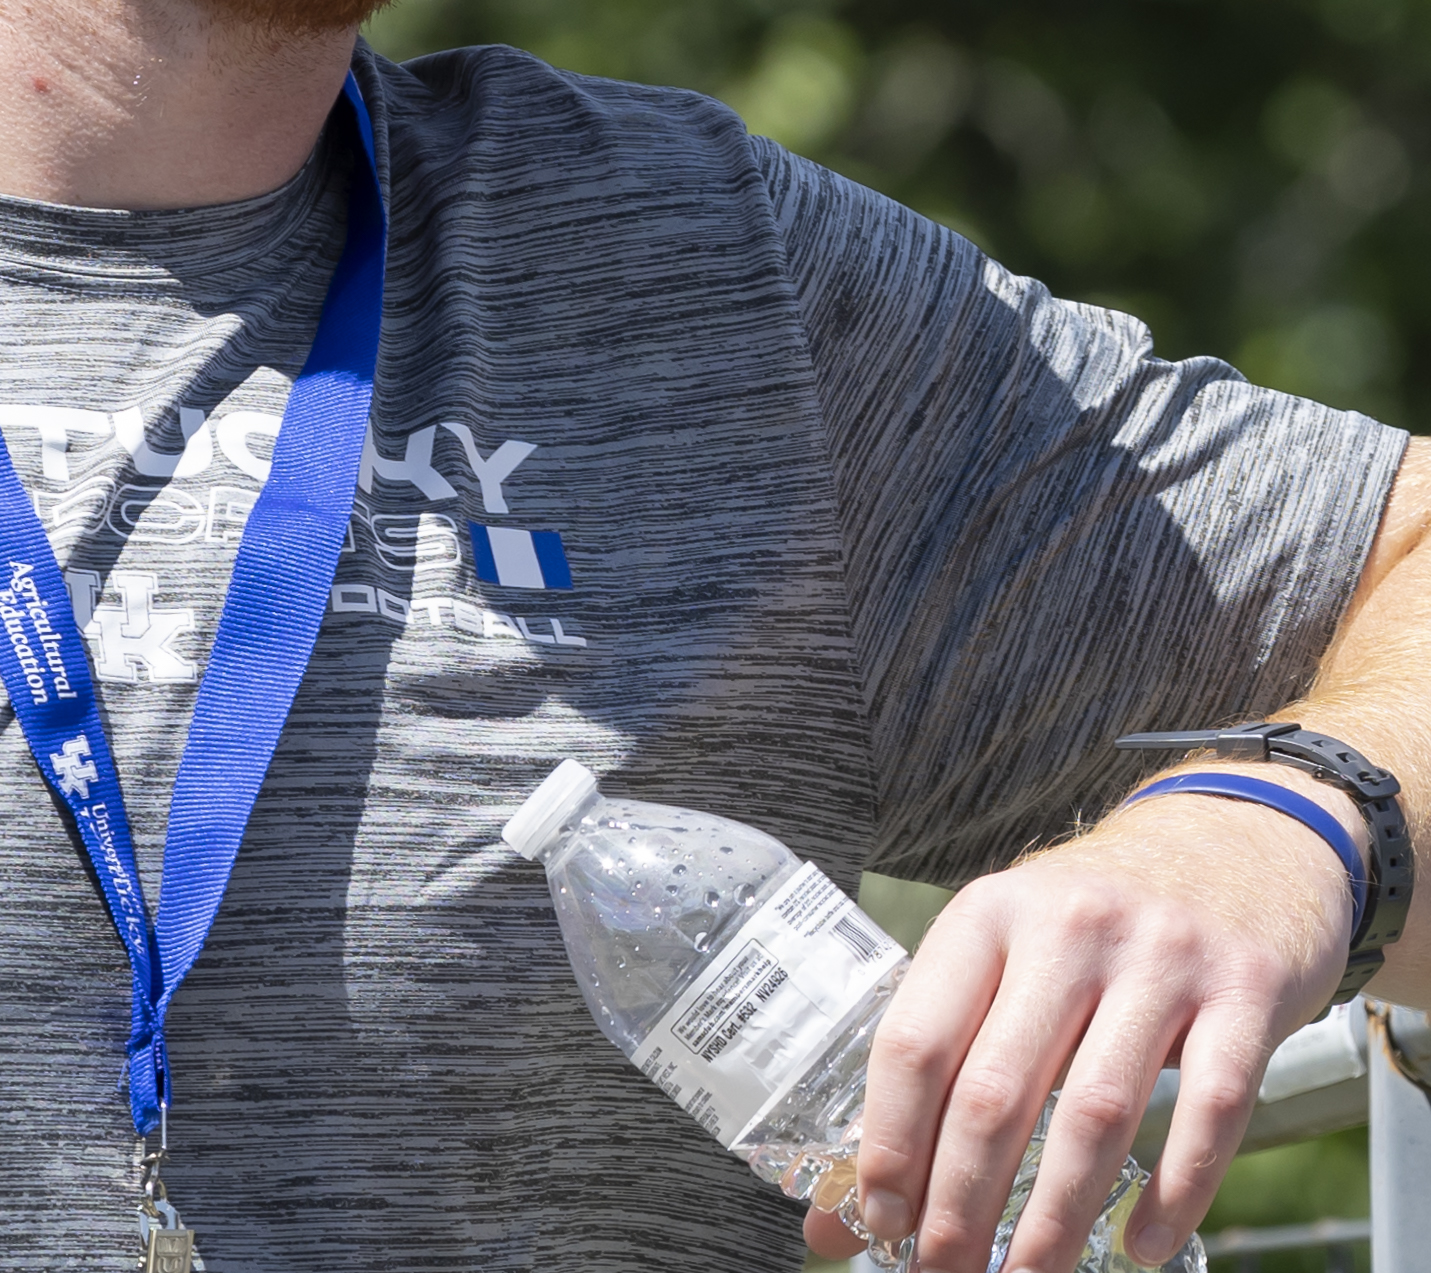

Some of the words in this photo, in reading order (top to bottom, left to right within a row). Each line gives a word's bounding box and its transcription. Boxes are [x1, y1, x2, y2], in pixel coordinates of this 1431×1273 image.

[8, 559, 78, 699] Agricultural
[331, 585, 587, 647] OOTBALL
[682, 1008, 700, 1027] would
[695, 997, 710, 1013] love
[720, 965, 739, 985] about
[735, 954, 751, 971] your
[703, 1003, 718, 1019] Mark
[700, 1034, 727, 1063] NYSHD
[719, 1017, 743, 1041] Cert.
